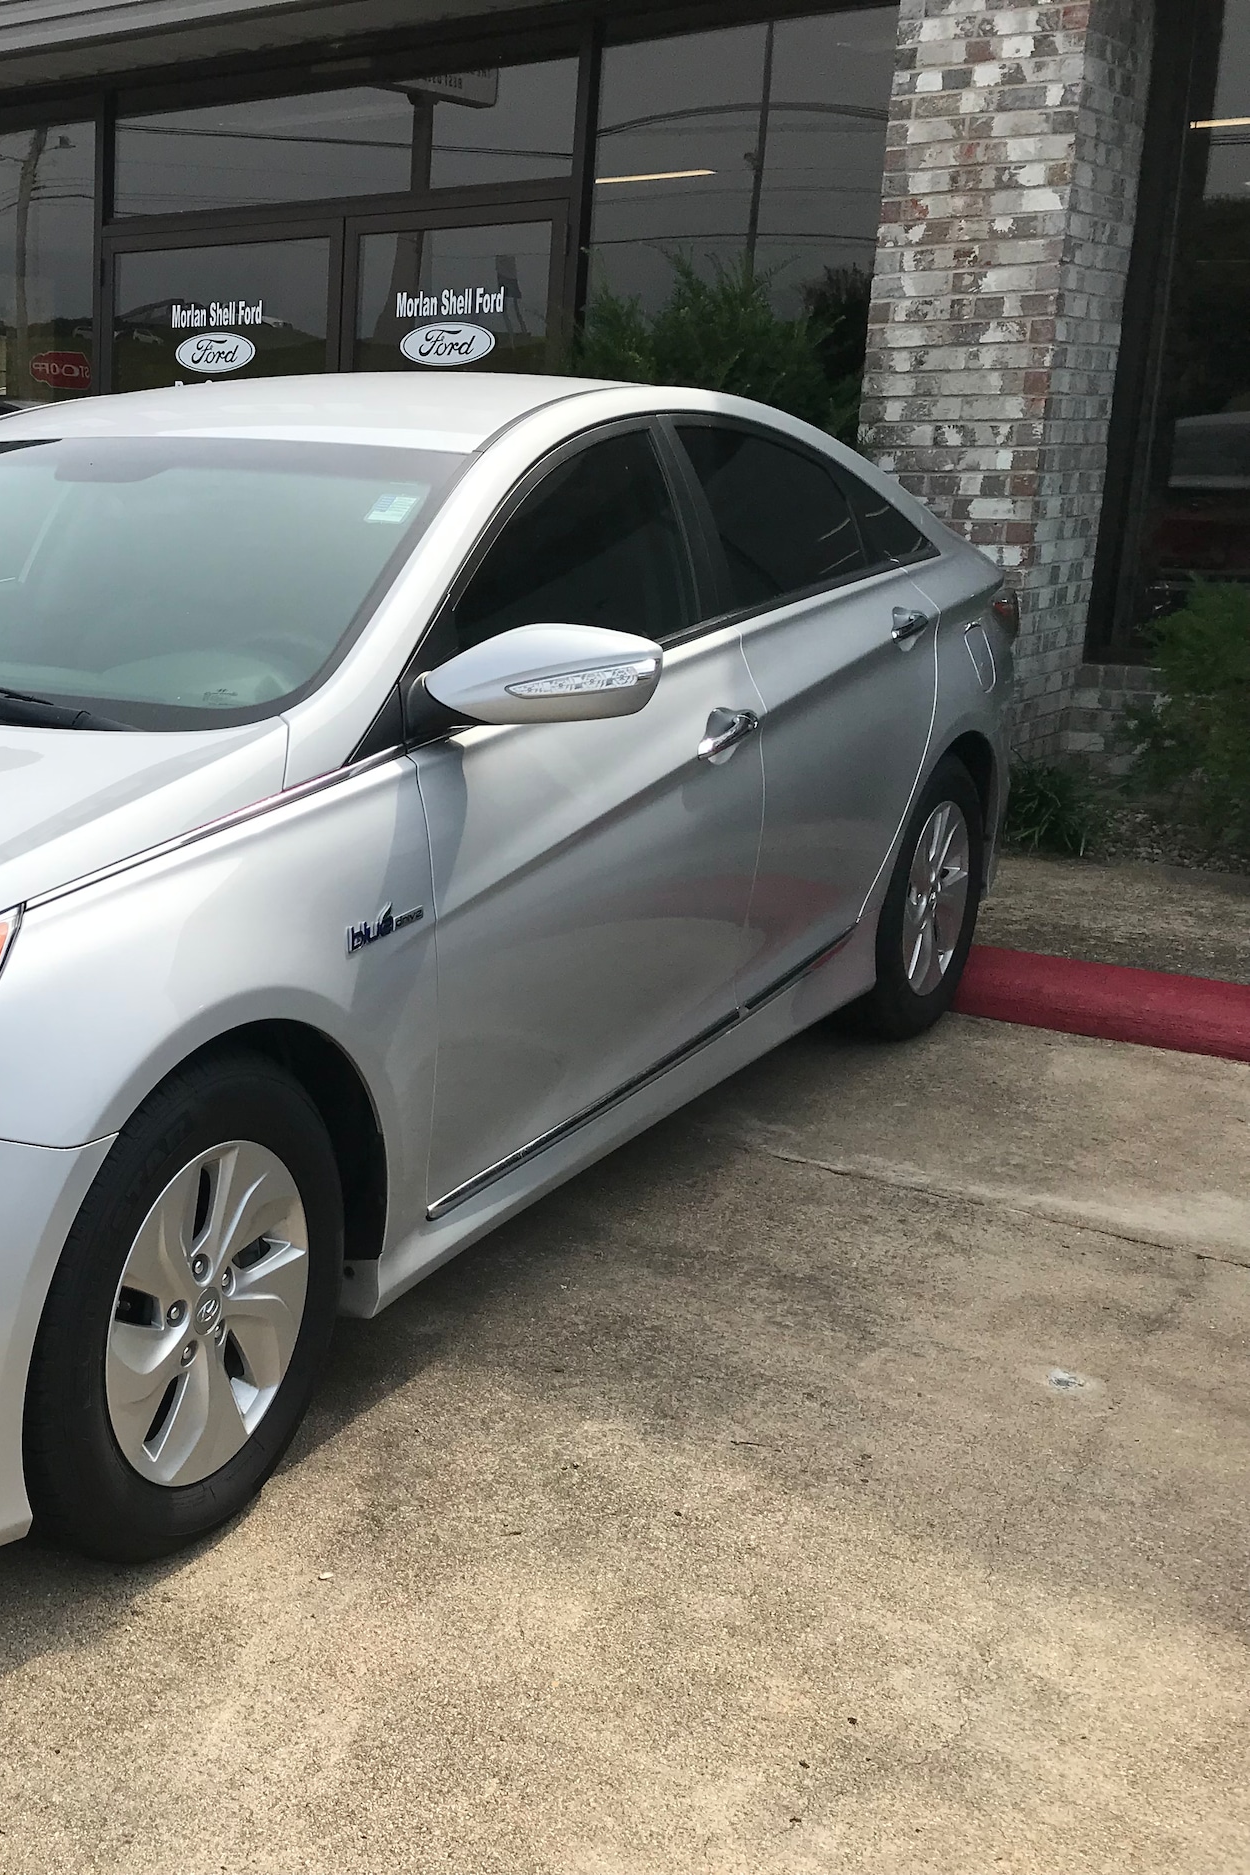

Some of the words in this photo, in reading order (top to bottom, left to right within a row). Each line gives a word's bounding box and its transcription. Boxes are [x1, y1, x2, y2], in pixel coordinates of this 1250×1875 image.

[171, 304, 207, 328] Morlan
[209, 301, 236, 327] Shell
[238, 299, 263, 326] Ford
[396, 291, 438, 318] Morlan
[441, 287, 473, 316] Shell
[475, 285, 505, 314] Ford
[191, 338, 239, 364] Ford
[419, 329, 476, 356] Ford
